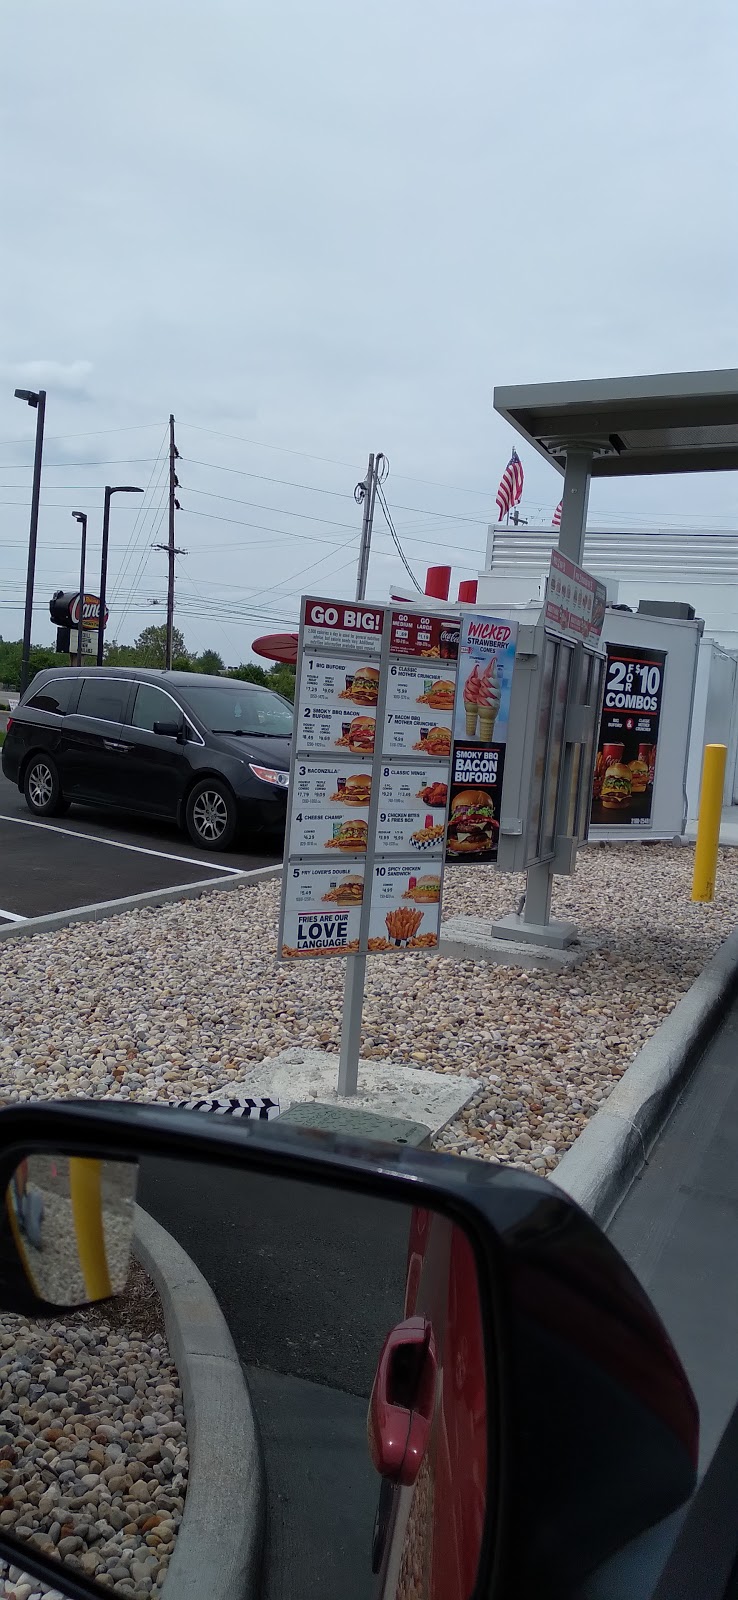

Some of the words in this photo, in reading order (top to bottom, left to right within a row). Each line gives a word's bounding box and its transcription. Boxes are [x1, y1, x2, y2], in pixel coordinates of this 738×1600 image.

[311, 606, 338, 625] GO
[343, 610, 380, 630] BIG!
[468, 622, 511, 641] WICKED
[467, 637, 509, 649] STRAWBERRY
[309, 660, 313, 670] 1
[391, 666, 397, 675] 6
[607, 662, 626, 691] 2
[635, 663, 660, 695] $10
[606, 692, 658, 711] COMBOS
[304, 708, 311, 718] 2
[388, 714, 393, 723] 7
[456, 750, 483, 759] SMOKY
[484, 752, 499, 760] BBQ
[455, 759, 498, 772] BACON
[299, 766, 306, 776] 3
[383, 768, 390, 777] 8
[455, 771, 497, 783] BUFORD
[296, 813, 303, 823] 4
[380, 813, 386, 822] 9
[293, 869, 300, 878] 5
[375, 867, 386, 876] 10
[319, 915, 333, 923] ARE
[298, 922, 348, 940] LOVE
[297, 938, 348, 949] LANGUAGE
